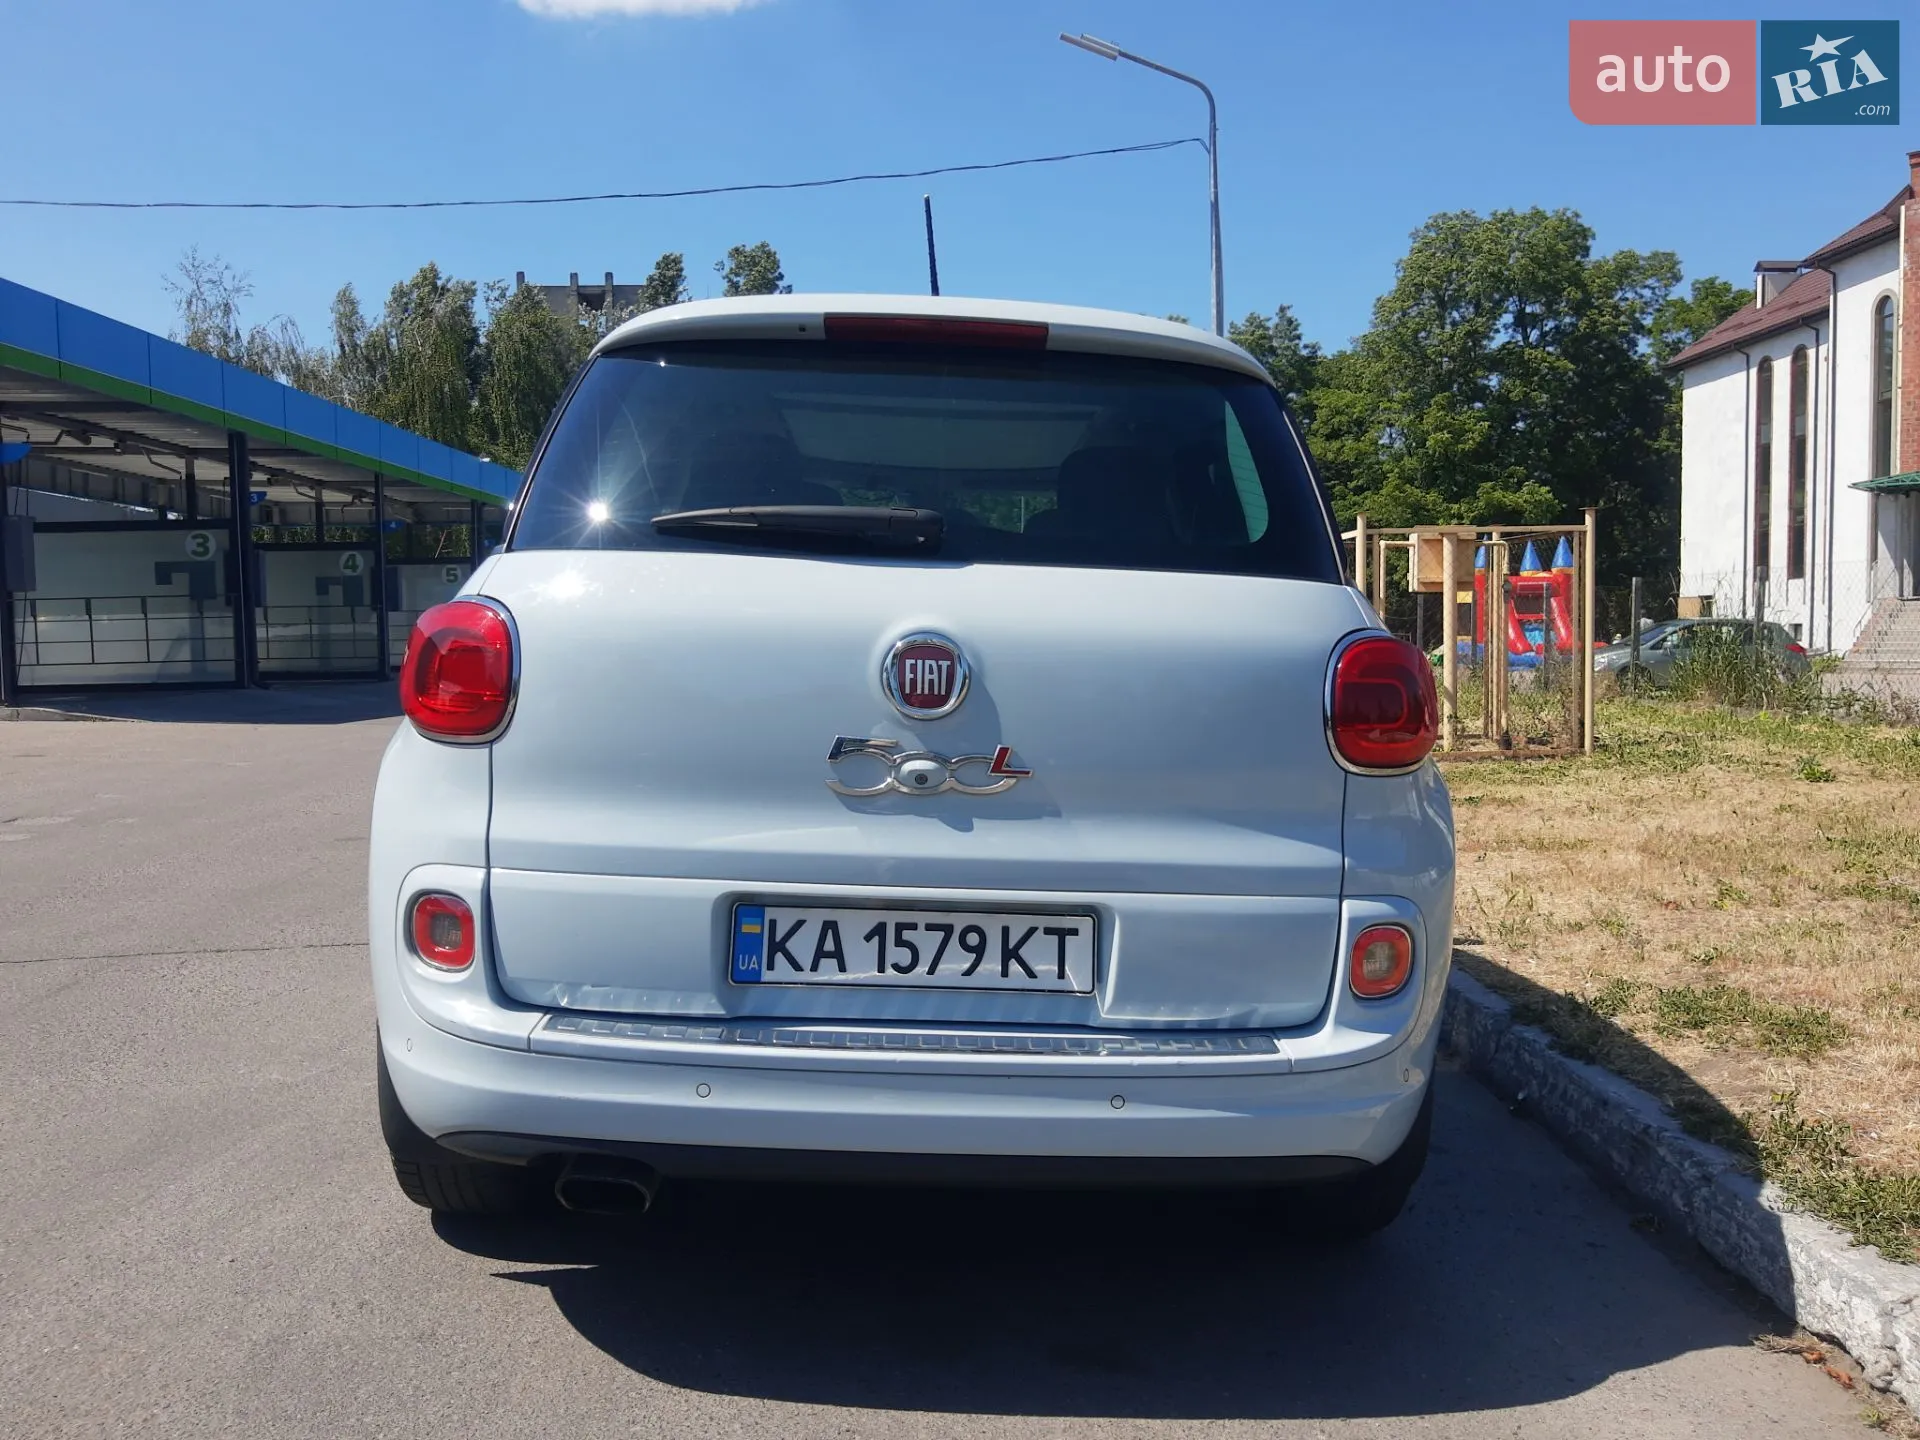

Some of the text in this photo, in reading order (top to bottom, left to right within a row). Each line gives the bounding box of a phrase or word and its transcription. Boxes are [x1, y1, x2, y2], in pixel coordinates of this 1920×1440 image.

[191, 534, 210, 557] 3
[342, 553, 361, 573] 4
[445, 567, 459, 583] 5
[905, 658, 952, 695] FIAT
[766, 918, 1080, 980] KA 1579 KT
[738, 953, 759, 972] UA
